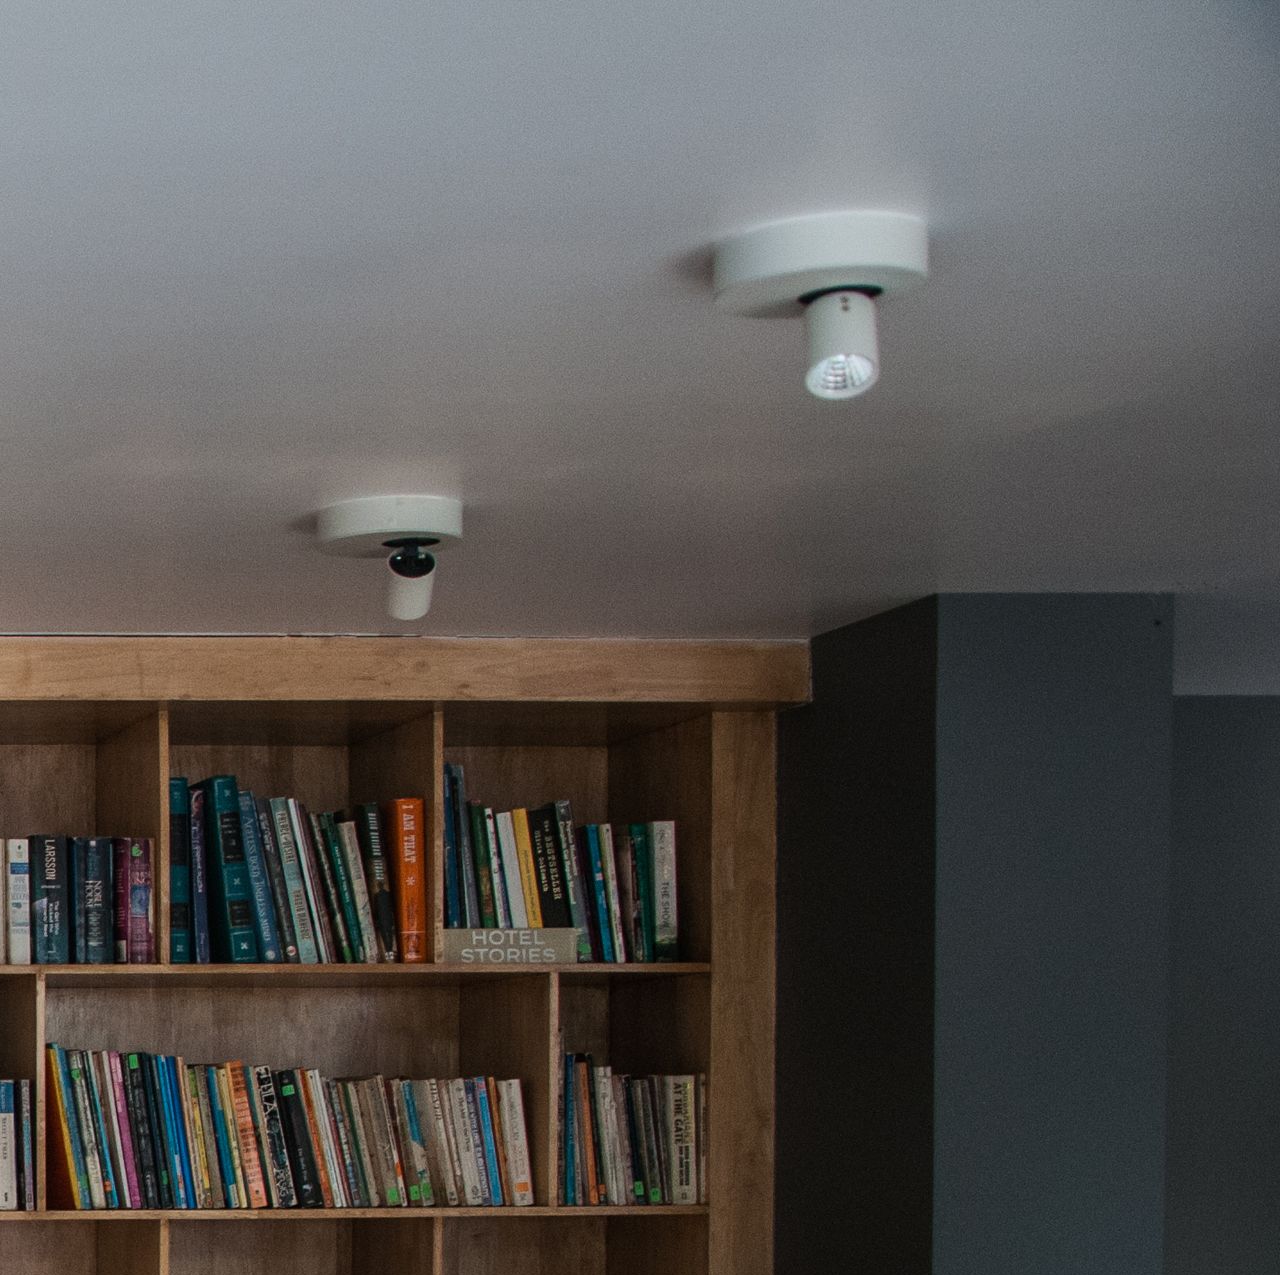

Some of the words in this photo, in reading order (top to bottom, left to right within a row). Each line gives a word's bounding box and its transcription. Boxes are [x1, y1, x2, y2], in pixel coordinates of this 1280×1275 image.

[402, 813, 414, 831] AM
[44, 839, 56, 880] LARSSON
[403, 834, 416, 863] THAT
[545, 836, 562, 900] BESTSELLER
[94, 880, 102, 907] NOBLE
[471, 930, 546, 946] HOTEL
[461, 949, 556, 963] STORIES
[673, 1082, 681, 1095] AT
[674, 1098, 682, 1115] THE
[674, 1119, 683, 1145] GATE
